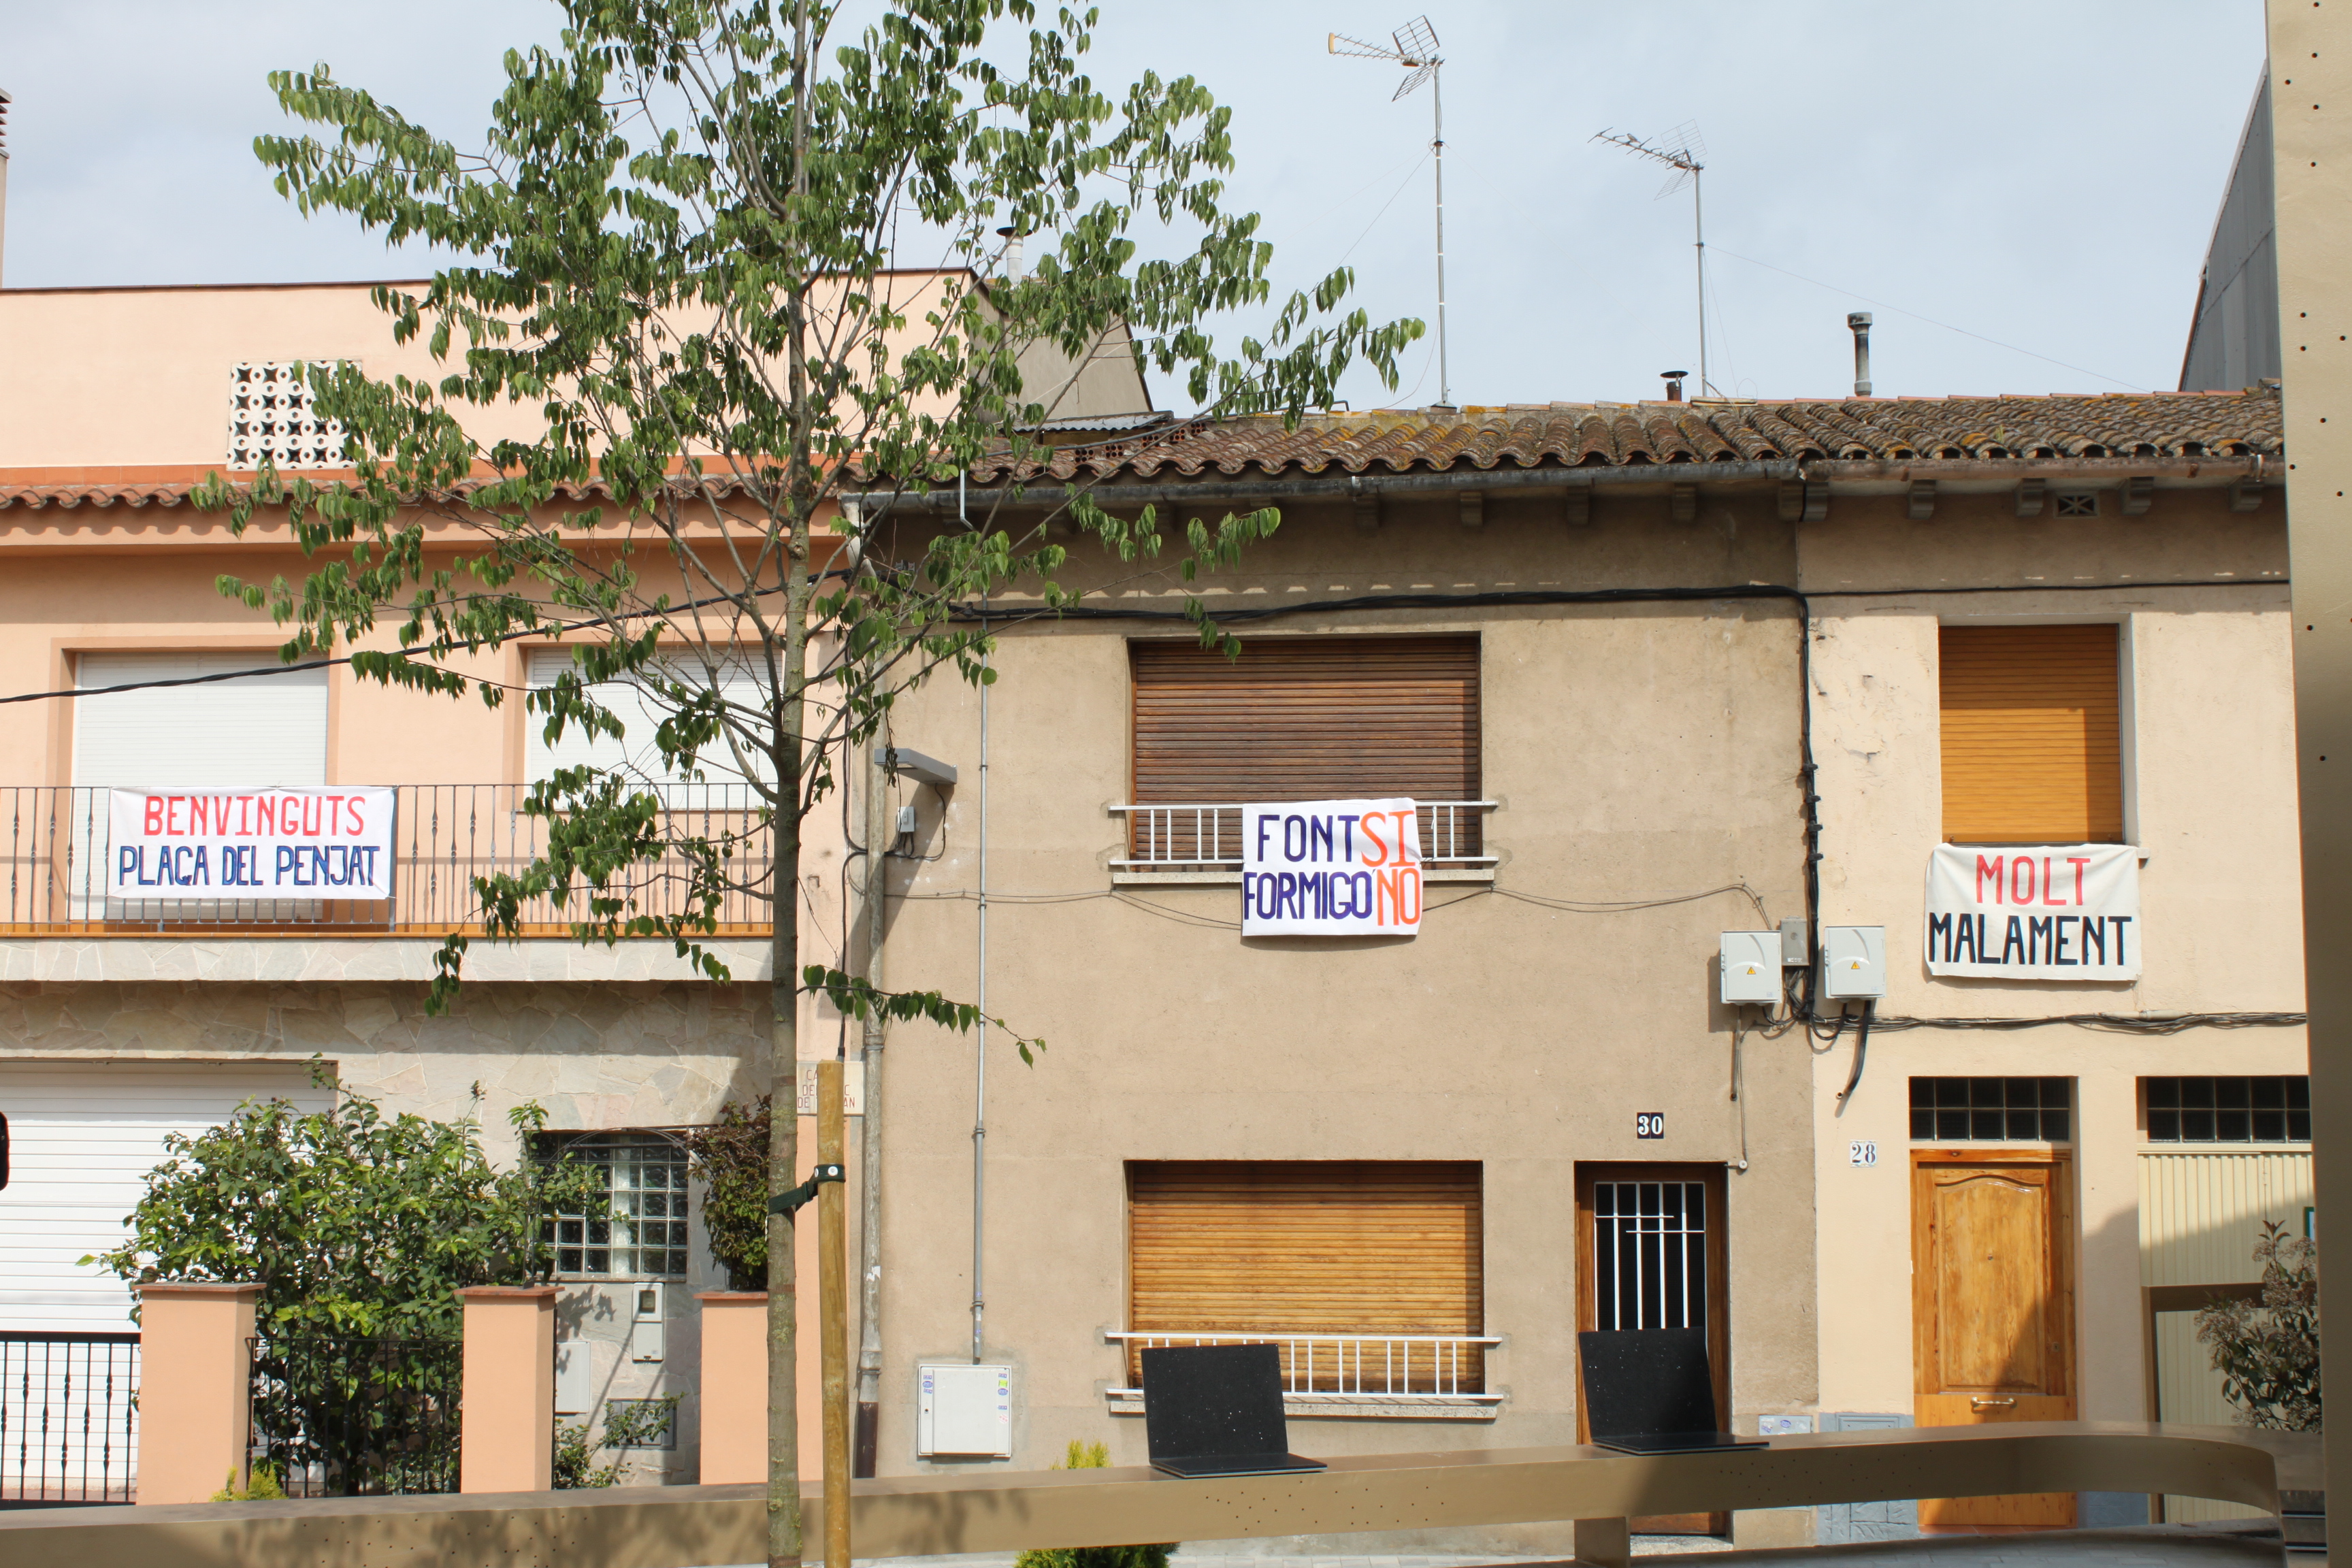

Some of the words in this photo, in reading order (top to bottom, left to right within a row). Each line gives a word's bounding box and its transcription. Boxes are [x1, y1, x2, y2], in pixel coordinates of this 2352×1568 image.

[144, 796, 365, 836] BENVINGUTS
[1258, 814, 1360, 862] FONT
[1360, 810, 1416, 868] SI
[222, 845, 263, 886] DEL
[275, 845, 380, 886] PENJAT
[1976, 854, 2091, 906] MOLT
[1376, 867, 1420, 926] NO
[1929, 912, 2132, 966] MALAMENT
[1637, 1115, 1663, 1135] 30
[1851, 1143, 1876, 1164] 28
